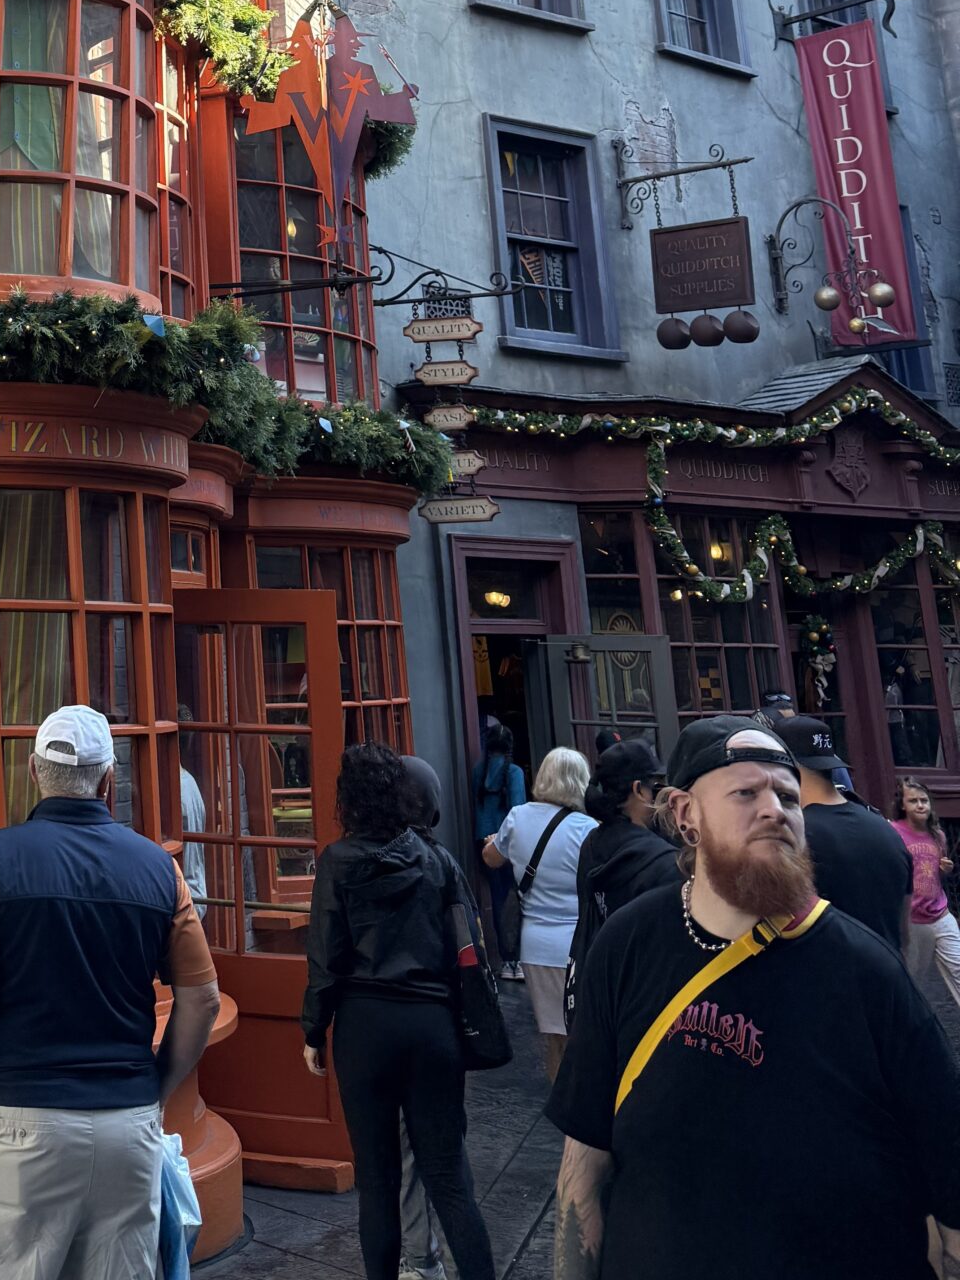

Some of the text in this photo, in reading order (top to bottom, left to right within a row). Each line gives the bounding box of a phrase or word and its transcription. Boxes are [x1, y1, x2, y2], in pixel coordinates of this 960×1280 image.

[668, 233, 729, 255] QUALITY
[661, 255, 740, 278] QUIDDITCH
[670, 278, 736, 297] SUPPLIES
[411, 322, 474, 336] QUALITY
[423, 367, 468, 378] STYLE
[433, 412, 467, 423] EASE
[484, 448, 551, 472] UALITY
[680, 459, 769, 482] QUIDDITCH
[427, 504, 488, 517] VARIETY
